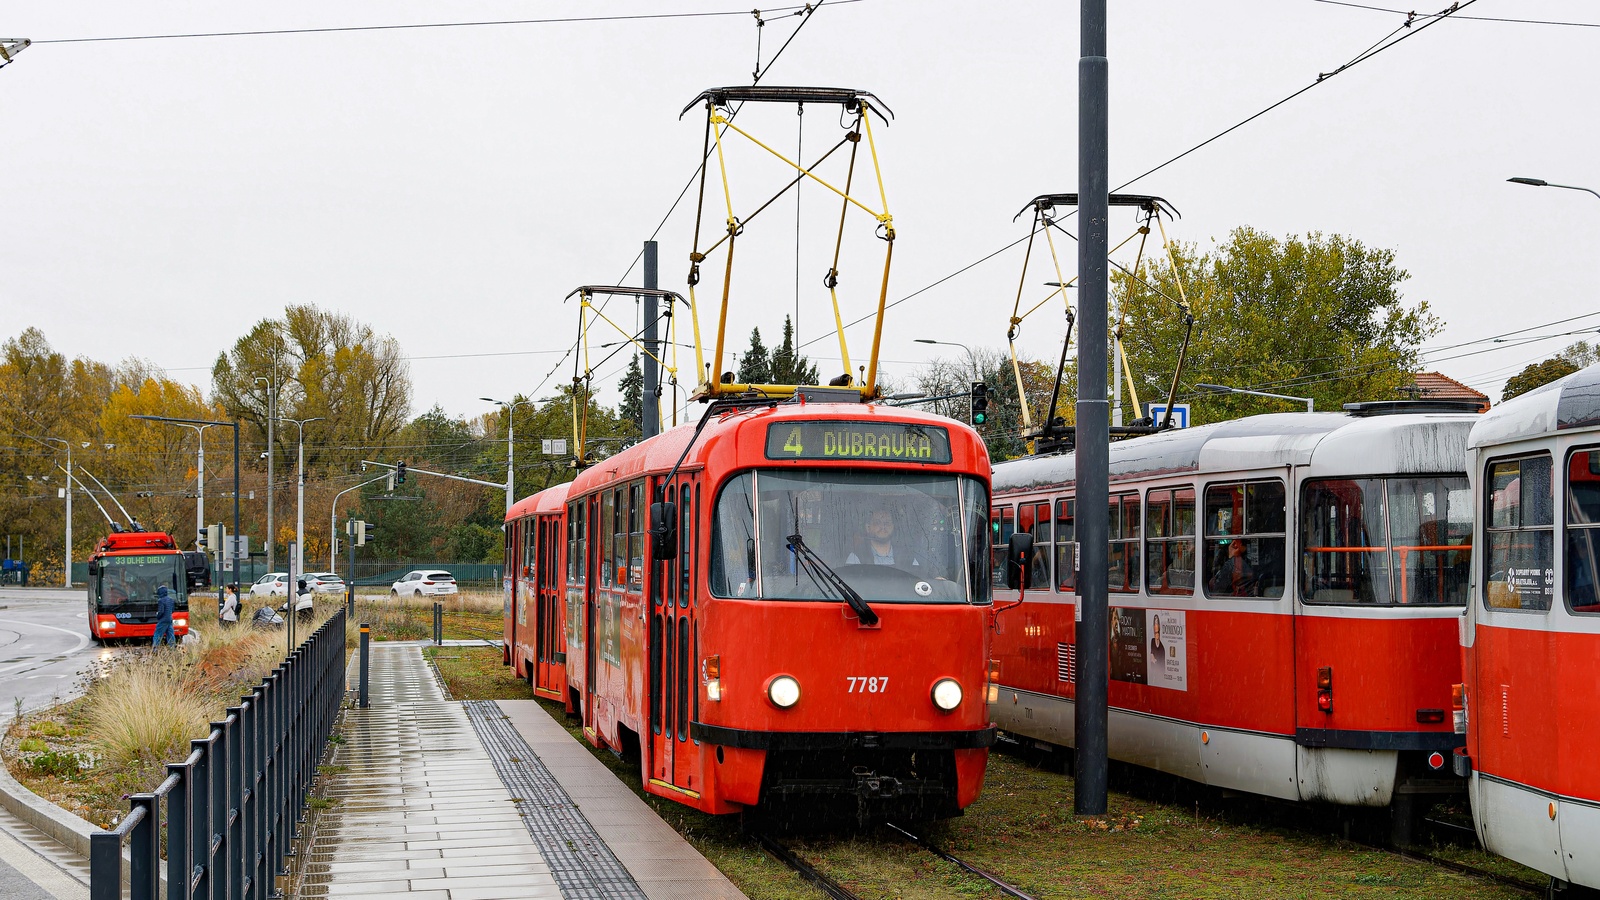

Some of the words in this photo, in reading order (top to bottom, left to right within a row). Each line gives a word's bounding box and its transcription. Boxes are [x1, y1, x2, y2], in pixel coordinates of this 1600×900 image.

[783, 427, 803, 456] 4
[115, 556, 126, 565] 33
[847, 676, 889, 693] 7787
